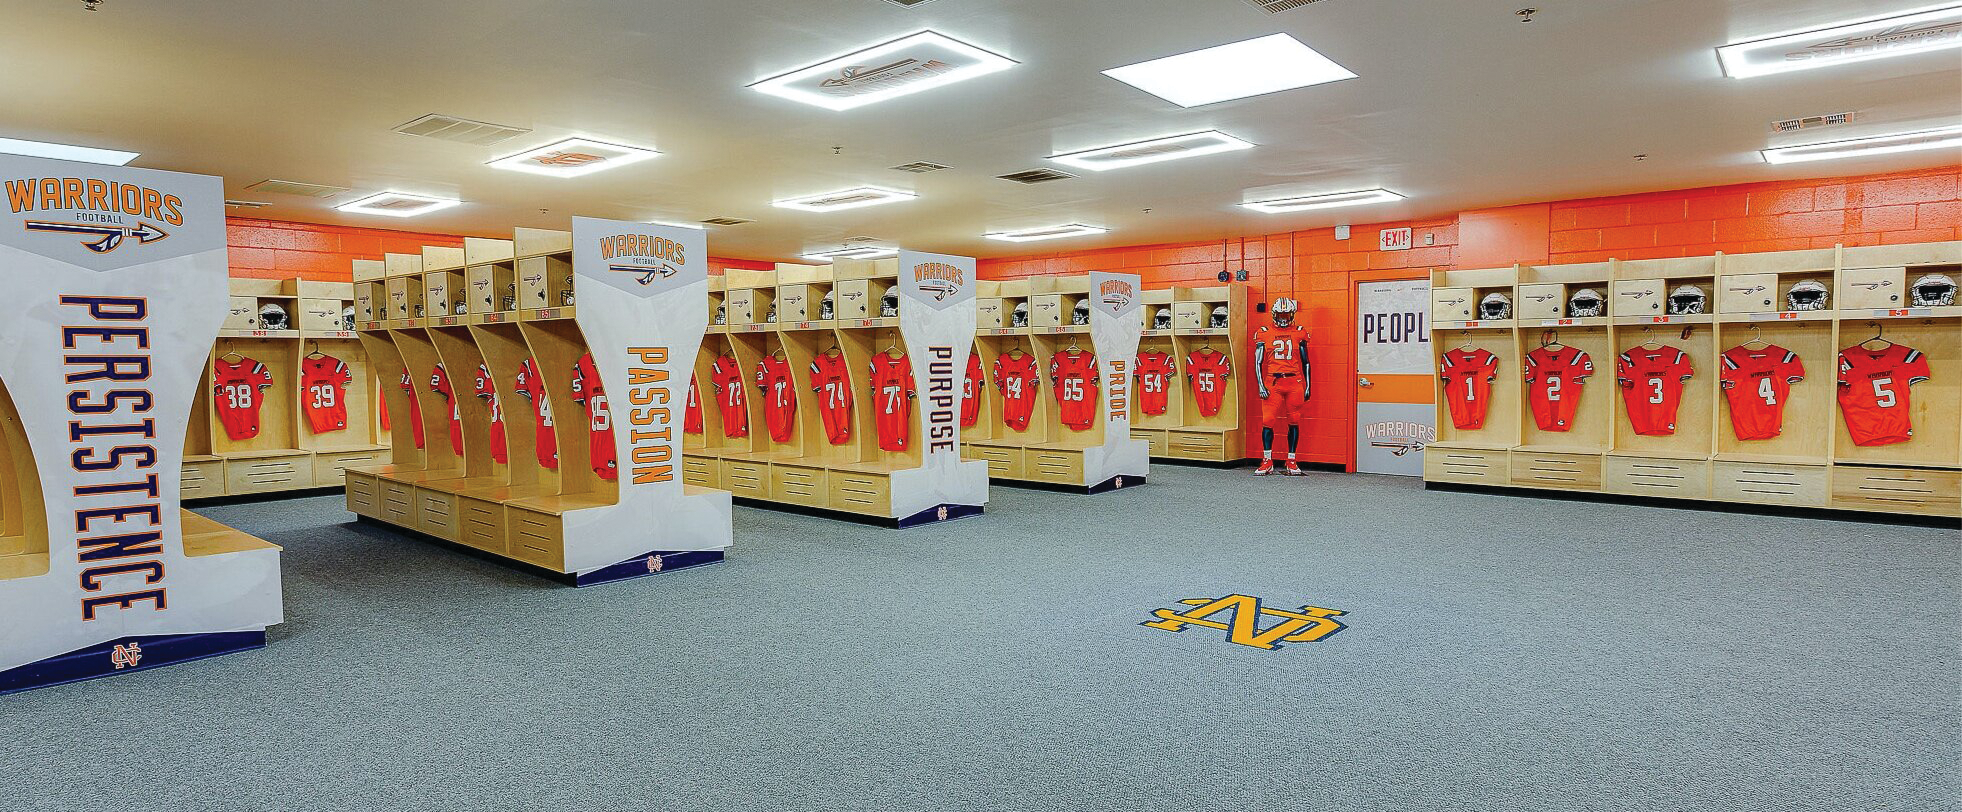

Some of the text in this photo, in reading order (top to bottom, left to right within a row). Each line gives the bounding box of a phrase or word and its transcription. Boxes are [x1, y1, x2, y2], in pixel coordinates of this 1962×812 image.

[5, 178, 184, 226] WARRIORS
[76, 212, 124, 225] FOOTBALL
[600, 233, 685, 266] WARRIORS
[1385, 230, 1408, 247] EXIT
[914, 262, 964, 287] WARRIORS
[1100, 279, 1133, 299] WARRIORS
[1363, 312, 1432, 343] PEOPL
[1272, 339, 1293, 360] 21
[517, 372, 525, 384] 4
[756, 371, 764, 381] 3
[1584, 361, 1593, 371] 2
[430, 374, 440, 386] 2
[476, 377, 484, 389] 3
[572, 379, 582, 392] 5
[1063, 378, 1084, 401] 65
[1109, 360, 1127, 422] PRIDE
[1144, 373, 1162, 393] 54
[1465, 376, 1475, 401] 1
[1546, 376, 1561, 401] 2
[1648, 378, 1664, 404] 3
[1758, 377, 1777, 405] 4
[225, 384, 252, 409] 38
[310, 384, 335, 409] 39
[928, 346, 954, 454] PURPOSE
[1871, 378, 1897, 409] 5
[627, 347, 673, 485] PASSION
[1365, 421, 1436, 442] WARRIORS
[59, 294, 168, 622] PERSISTENCE
